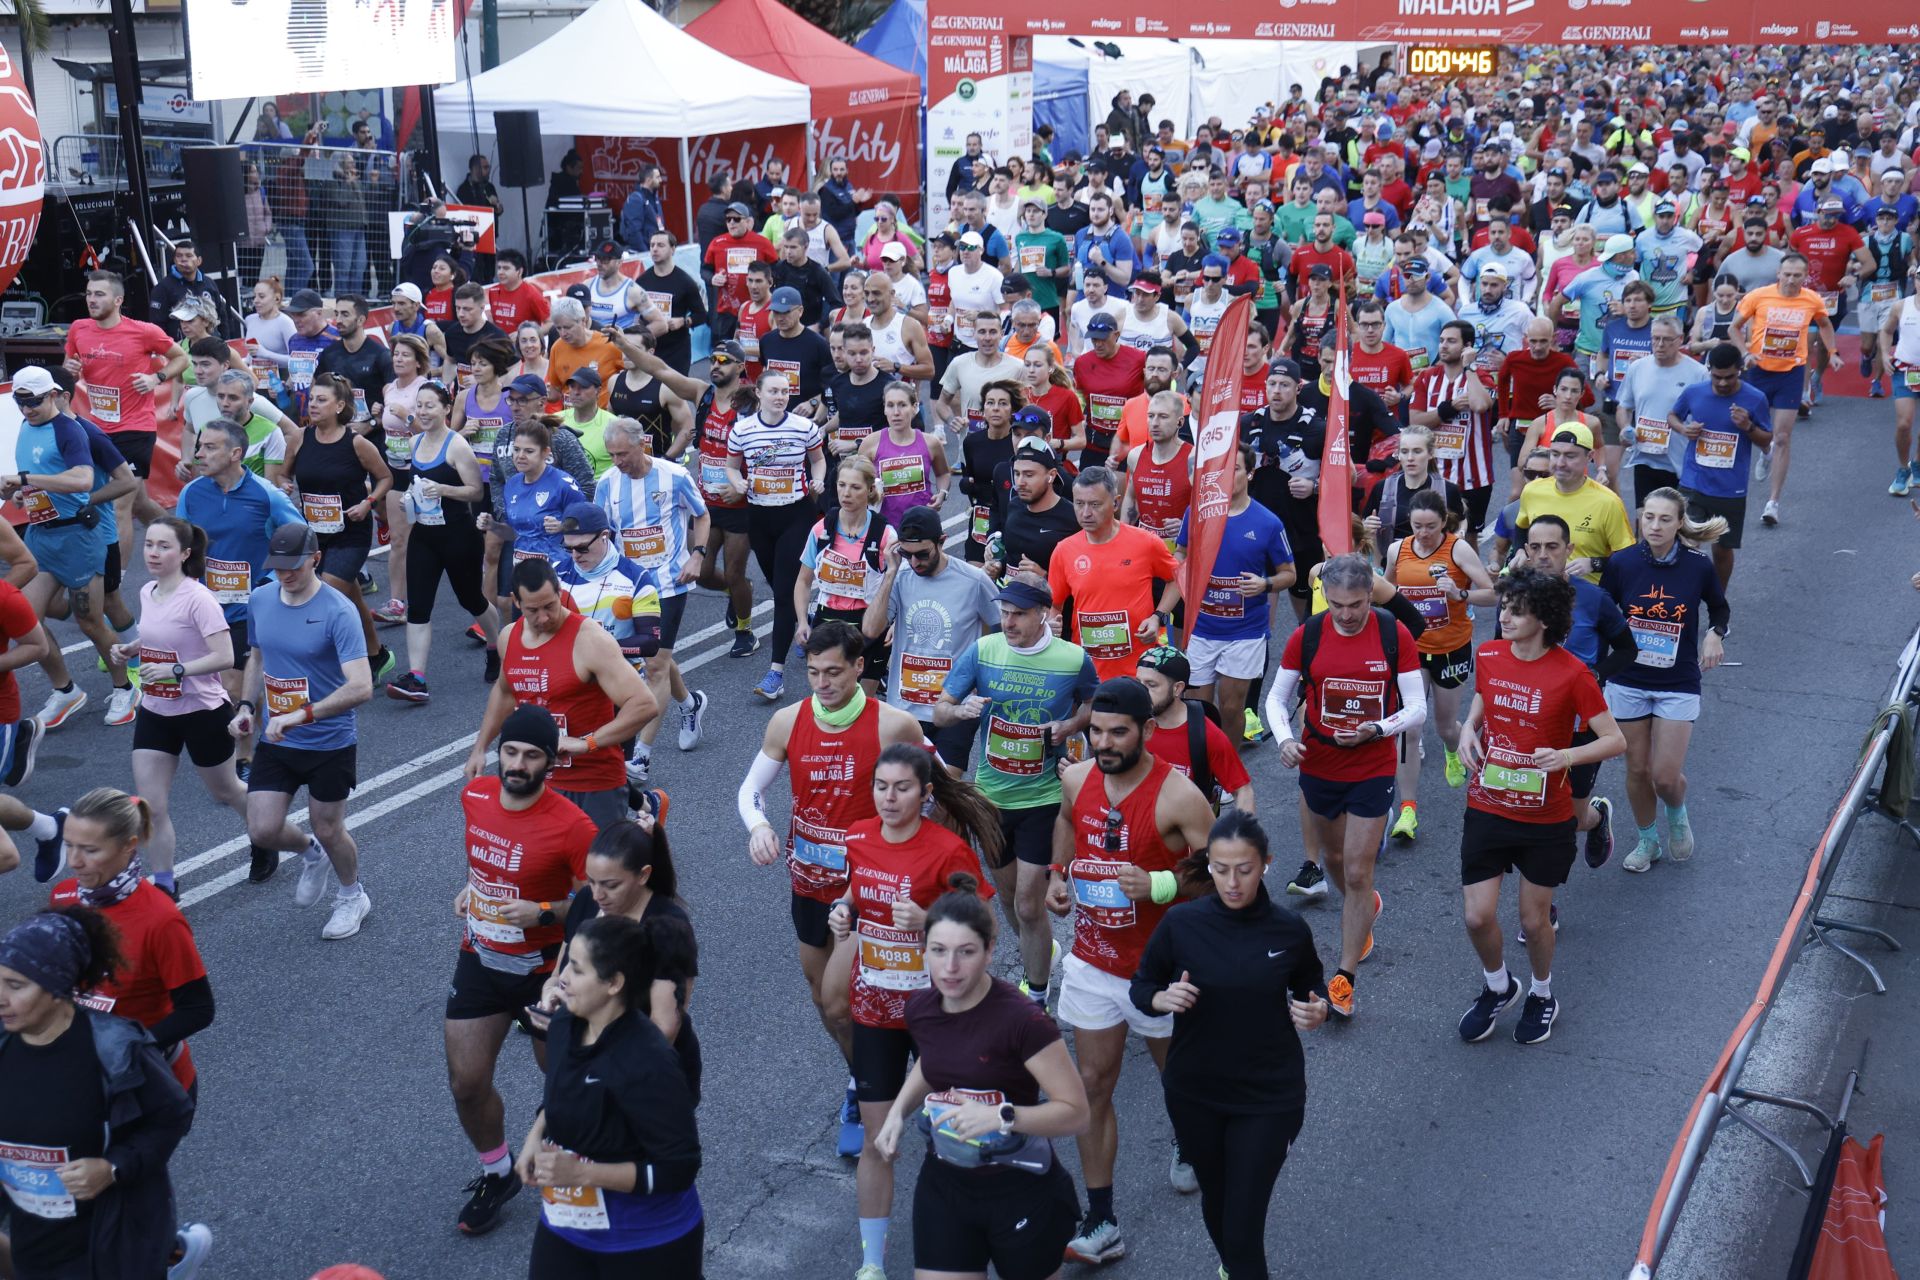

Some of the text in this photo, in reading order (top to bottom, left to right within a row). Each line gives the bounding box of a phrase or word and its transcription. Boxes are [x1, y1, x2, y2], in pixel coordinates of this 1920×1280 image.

[948, 16, 1004, 30] GENERALI
[1092, 18, 1122, 30] málaga
[1274, 24, 1336, 37] GENERALI
[1583, 26, 1652, 40] GENERALI
[1760, 24, 1798, 36] málaga
[1887, 28, 1908, 36] RUN
[944, 36, 986, 46] GENERALI
[944, 54, 988, 74] MÁLAGA
[858, 88, 888, 105] GENERALI
[810, 116, 900, 179] itality
[74, 200, 115, 210] SOLUCIONES
[1612, 337, 1650, 348] FAGERHULT
[1358, 376, 1381, 384] MÁLAGA
[706, 470, 727, 479] 1035
[762, 480, 786, 490] 13096
[1142, 487, 1164, 496] MÁLAGA
[310, 508, 334, 516] 15275
[630, 542, 657, 552] 10089
[214, 561, 247, 571] GENERALI
[211, 575, 240, 586] 14048
[1208, 590, 1231, 600] 2808
[1088, 613, 1123, 622] GENERALI
[1640, 621, 1677, 633] GENERALI
[1090, 630, 1116, 638] 4368
[912, 658, 948, 668] GENERALI
[1440, 661, 1469, 680] NIKE
[269, 678, 302, 688] GENERALI
[912, 674, 937, 684] 5592
[513, 681, 540, 692] MÁLAGA
[988, 680, 1056, 698] MADRID RIO
[1340, 683, 1379, 692] GENERALI
[1498, 680, 1530, 694] GENERALI
[272, 694, 293, 706] 7791
[1345, 700, 1360, 710] 80
[1494, 694, 1528, 712] MÁLAGA
[1001, 740, 1030, 754] 4815
[1502, 754, 1536, 765] GENERA
[1498, 770, 1528, 784] 4138
[476, 828, 512, 848] GENERALI
[804, 828, 846, 842] GENERALI
[472, 844, 507, 870] MÁLAGA
[863, 868, 898, 883] GENERALI
[860, 884, 897, 904] MÁLAGA
[1086, 884, 1114, 898] 2593
[474, 897, 499, 916] 1408
[873, 928, 918, 942] GENERALI
[872, 946, 912, 963] 14088
